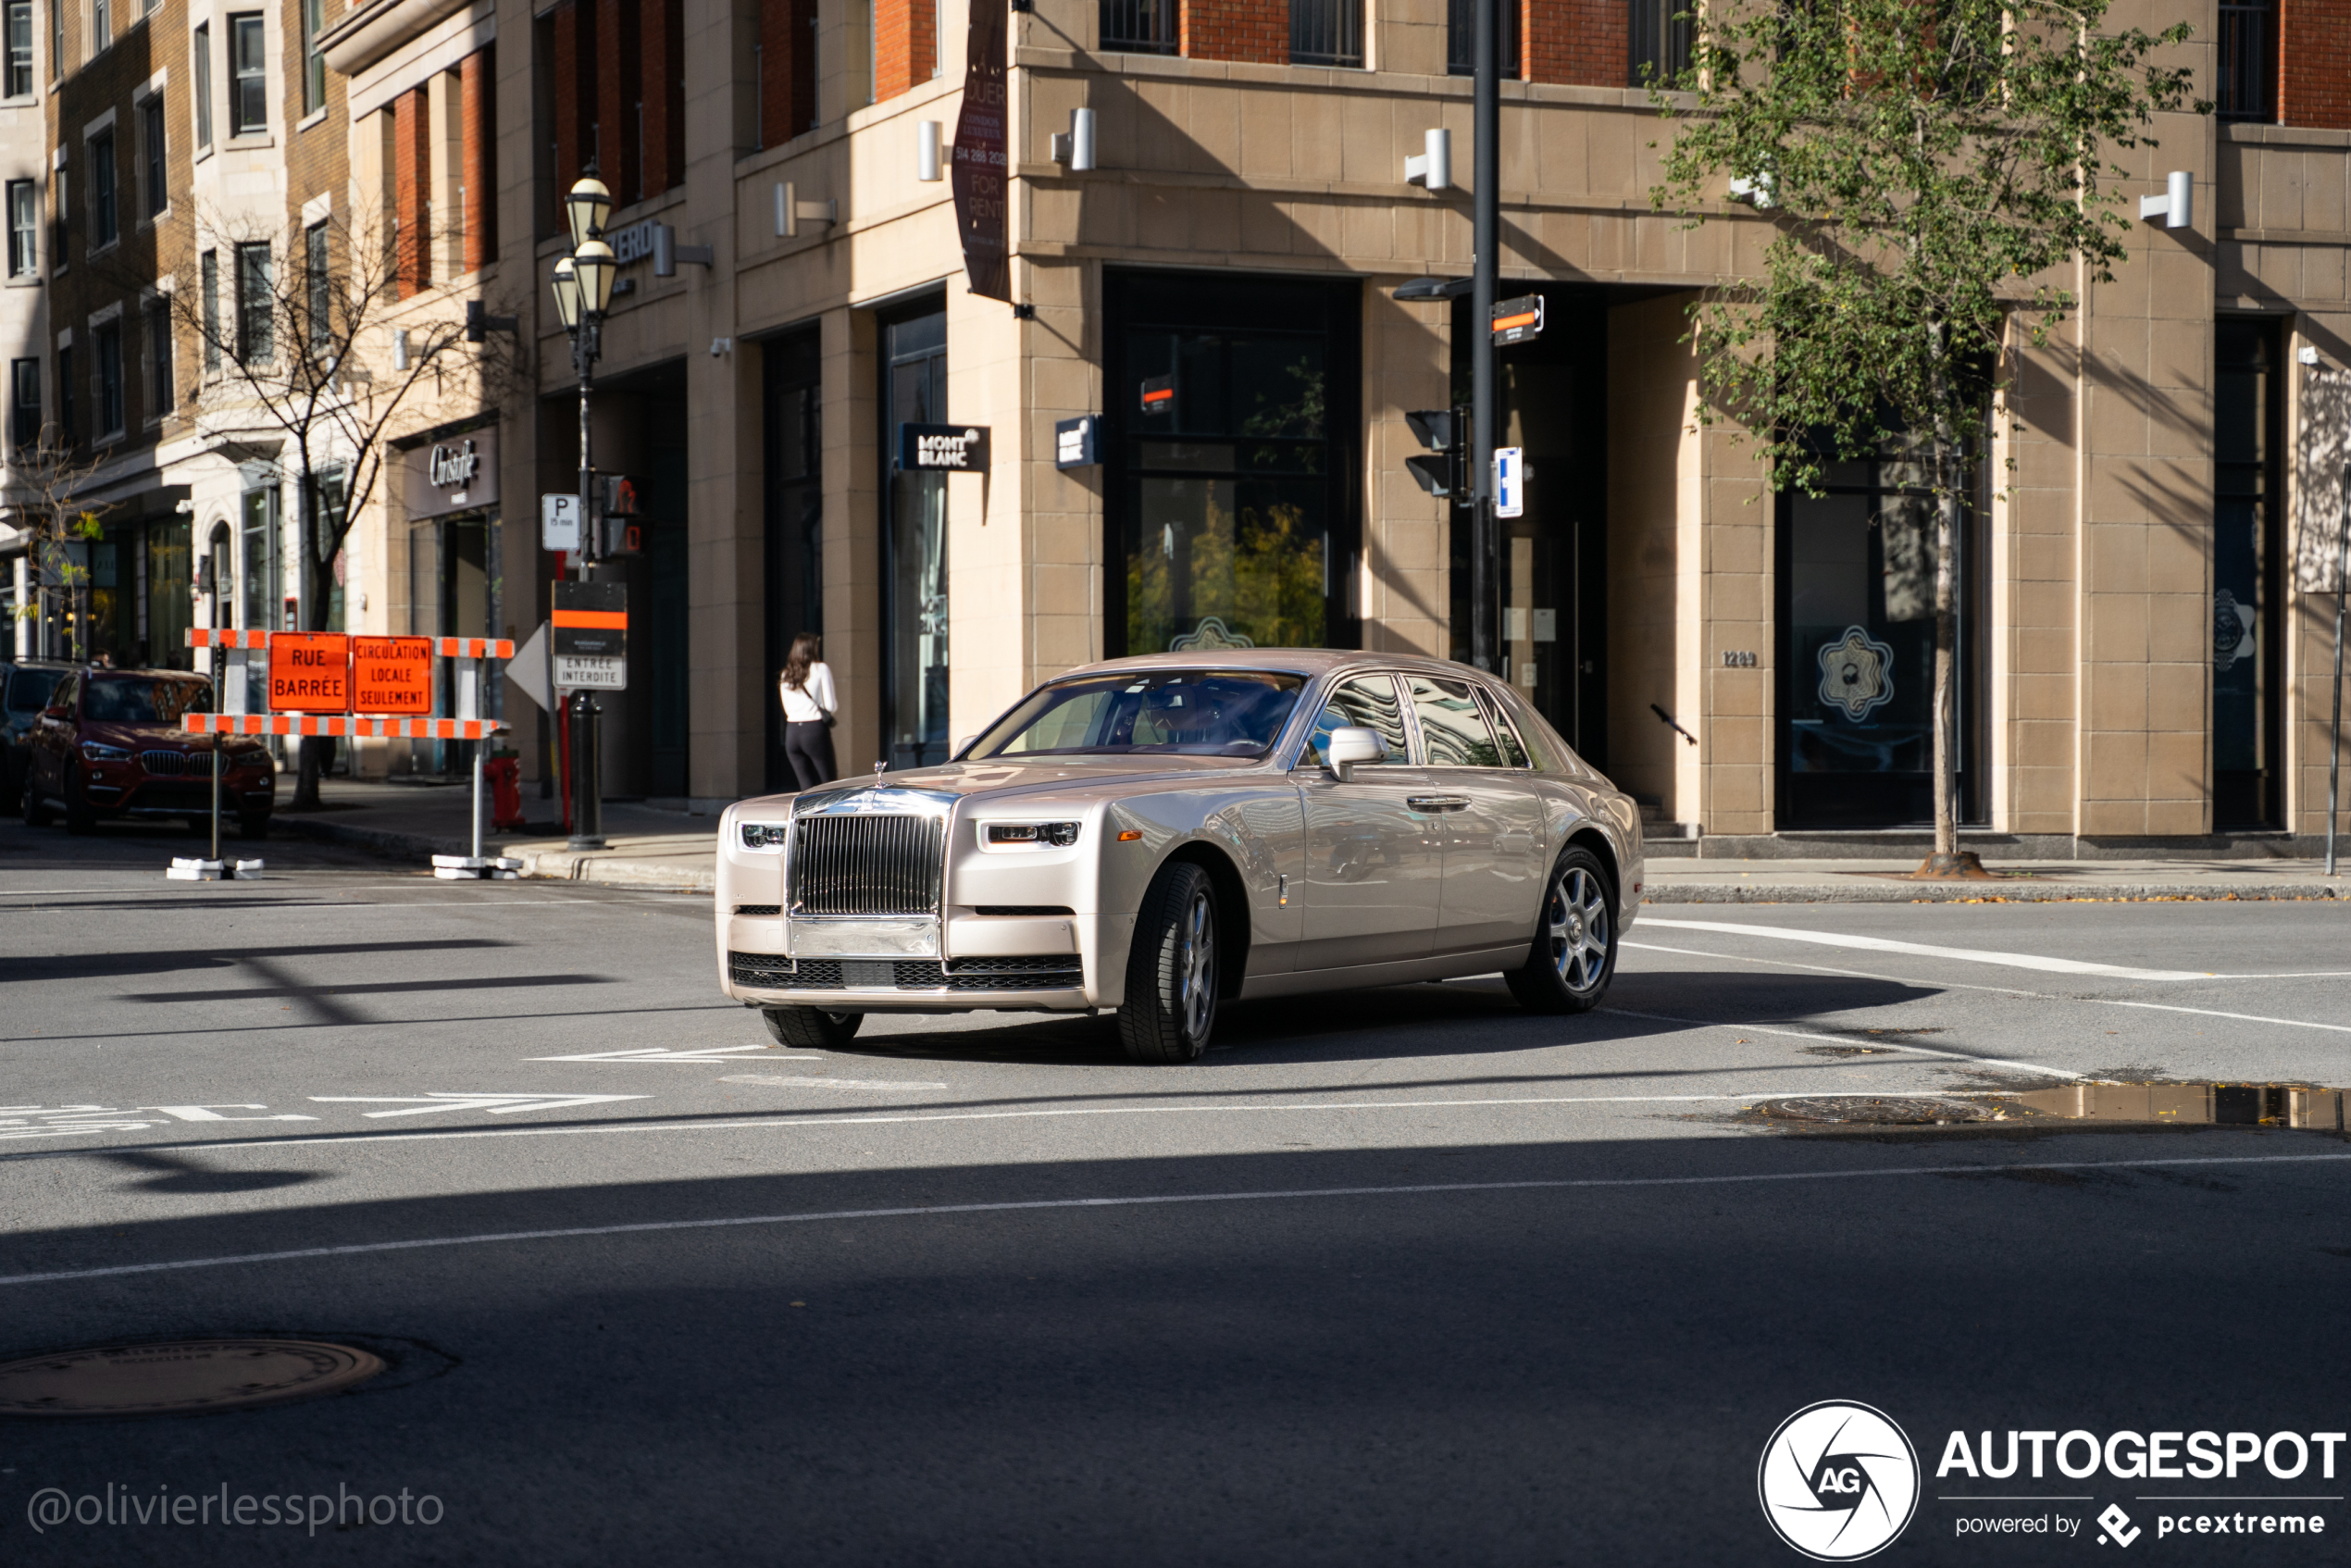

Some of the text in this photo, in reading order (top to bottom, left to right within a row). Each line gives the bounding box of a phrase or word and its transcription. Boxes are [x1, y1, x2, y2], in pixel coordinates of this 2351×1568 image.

[955, 146, 969, 160] 514
[970, 174, 1001, 196] FOR
[968, 196, 1003, 218] RENT
[917, 435, 967, 452] MONT
[917, 450, 968, 467] BLANC
[555, 498, 568, 516] P
[559, 518, 573, 527] min
[292, 650, 326, 666] RUE
[356, 645, 428, 660] CIRCULATION
[1721, 650, 1754, 666] 1289
[566, 656, 613, 669] ENTRÉE
[371, 668, 412, 683] LOCALE
[562, 670, 616, 683] INTERDITE
[275, 675, 342, 696] BARRÉE
[360, 691, 423, 705] SEULEMENT
